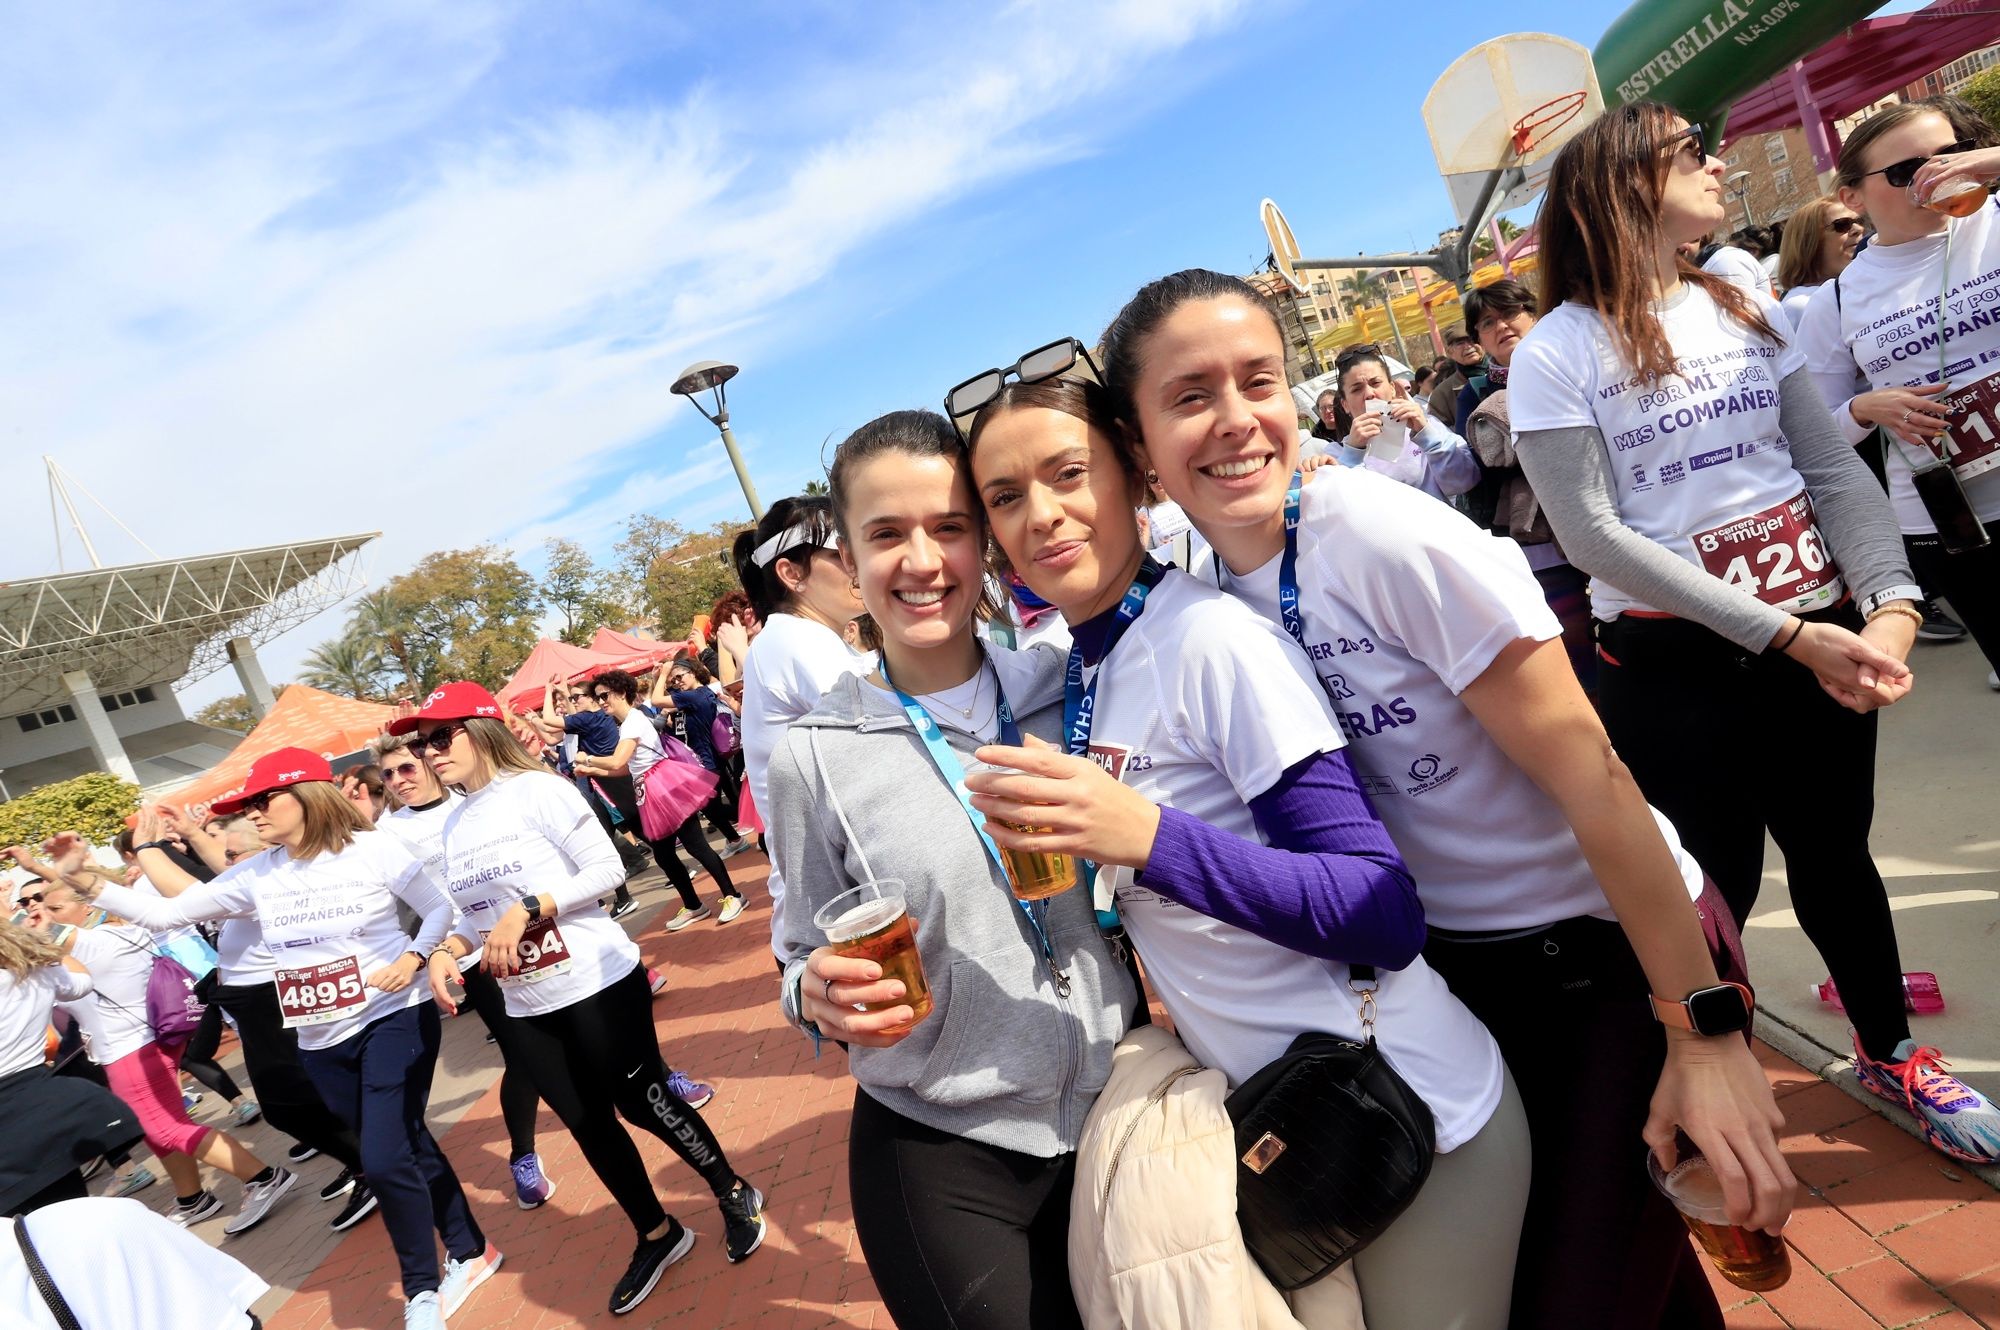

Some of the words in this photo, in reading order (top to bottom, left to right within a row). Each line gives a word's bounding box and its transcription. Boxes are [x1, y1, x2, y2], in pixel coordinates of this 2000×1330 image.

[1616, 0, 1749, 104] ESTRELLA
[1855, 326, 1871, 339] VIII
[1873, 304, 1922, 330] CARRERA
[1926, 295, 1941, 307] DE
[1944, 288, 1960, 299] LA
[1876, 323, 1915, 348] POR
[1948, 300, 1964, 315] Y
[1599, 381, 1628, 400] VIII
[1689, 358, 1706, 369] DE
[1707, 354, 1723, 365] LA
[1723, 347, 1758, 362] MUJER
[1637, 384, 1686, 413] POR
[1684, 367, 1717, 395] MÍ
[1716, 370, 1733, 387] Y
[1733, 366, 1769, 384] POR
[1947, 390, 1978, 413] ujer
[1613, 424, 1656, 451] MIS
[1660, 472, 1686, 484] Murcia
[1717, 519, 1755, 537] carrera
[1731, 515, 1784, 544] mujer
[1796, 579, 1820, 593] CECI
[1407, 783, 1429, 795] Pacto
[1434, 766, 1459, 783] Estado
[450, 860, 523, 893] COMPAÑERAS
[463, 855, 474, 872] MÍ
[274, 903, 364, 927] COMPAÑERAS
[293, 894, 309, 909] MÍ
[515, 929, 563, 965] 94
[317, 958, 354, 974] MURCIA
[282, 974, 361, 1009] 4895
[647, 1083, 685, 1128] PRO
[674, 1121, 717, 1166] NIKE
